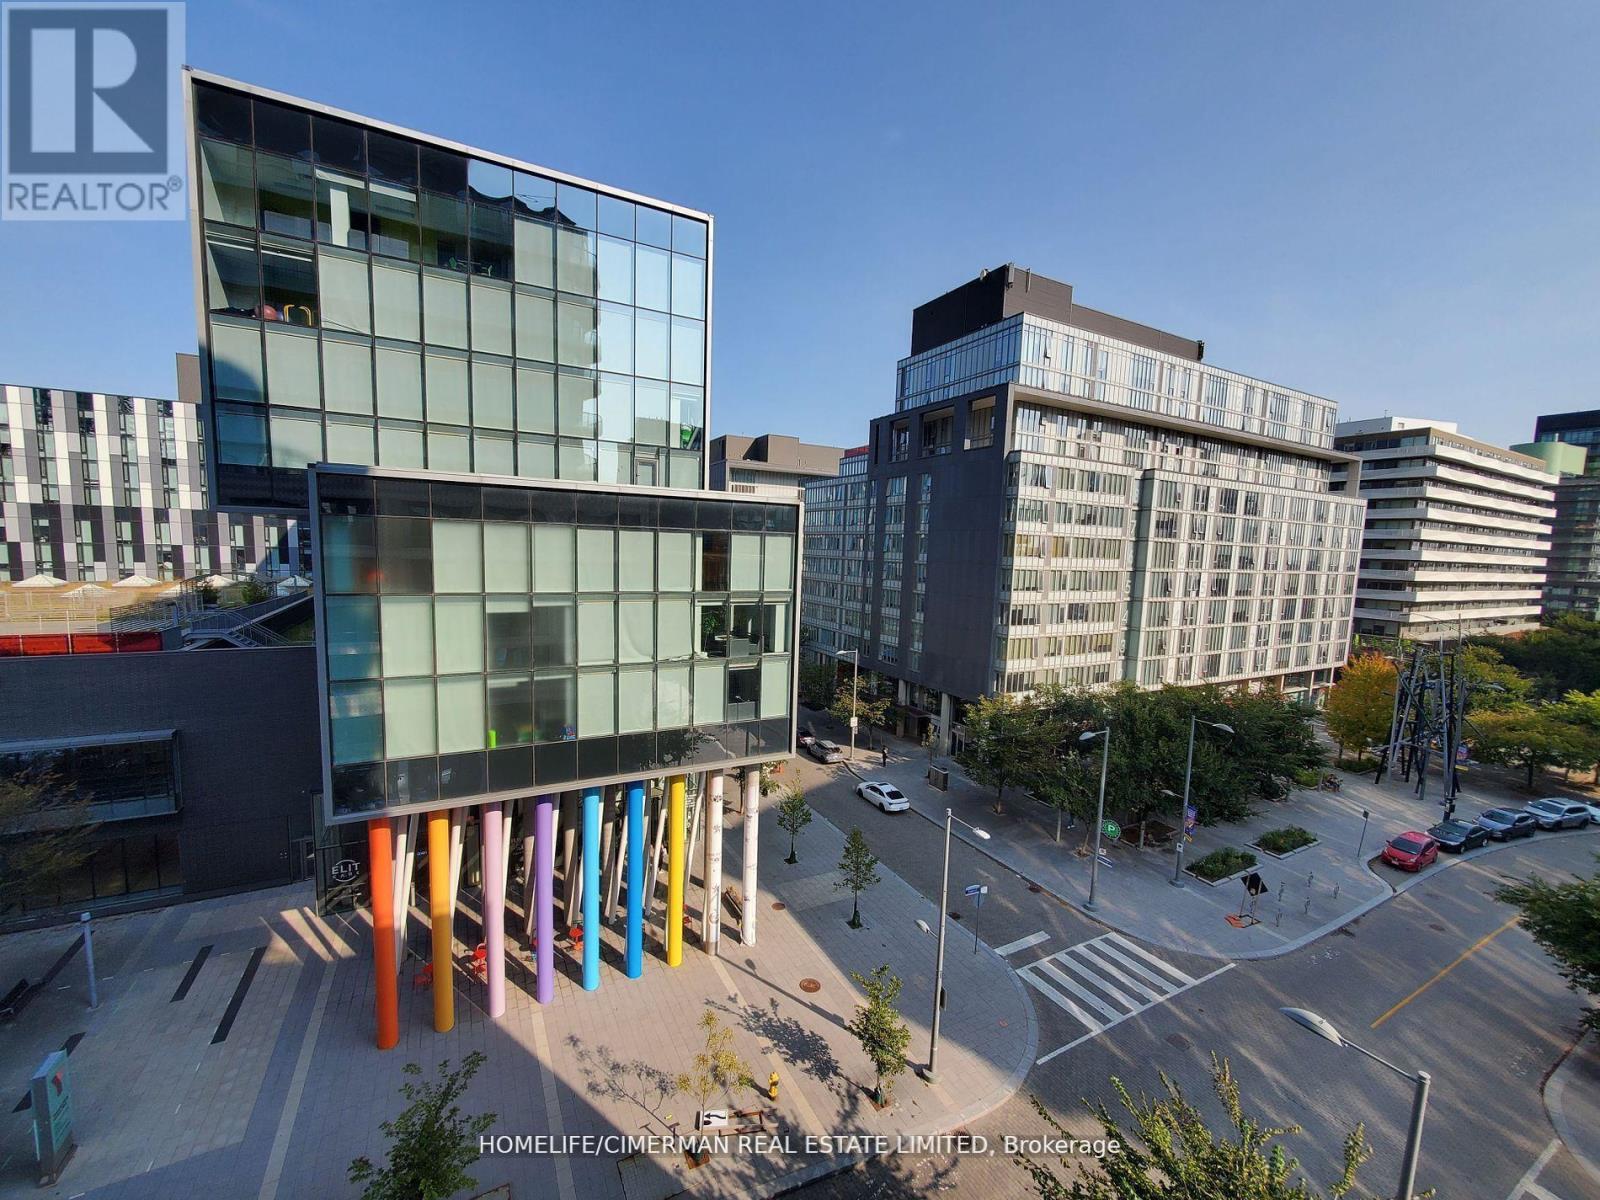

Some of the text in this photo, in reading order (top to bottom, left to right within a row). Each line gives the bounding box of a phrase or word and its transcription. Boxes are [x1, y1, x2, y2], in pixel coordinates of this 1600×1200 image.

[1130, 519, 1137, 535] 7
[1125, 580, 1132, 594] 5
[1121, 608, 1129, 624] 4
